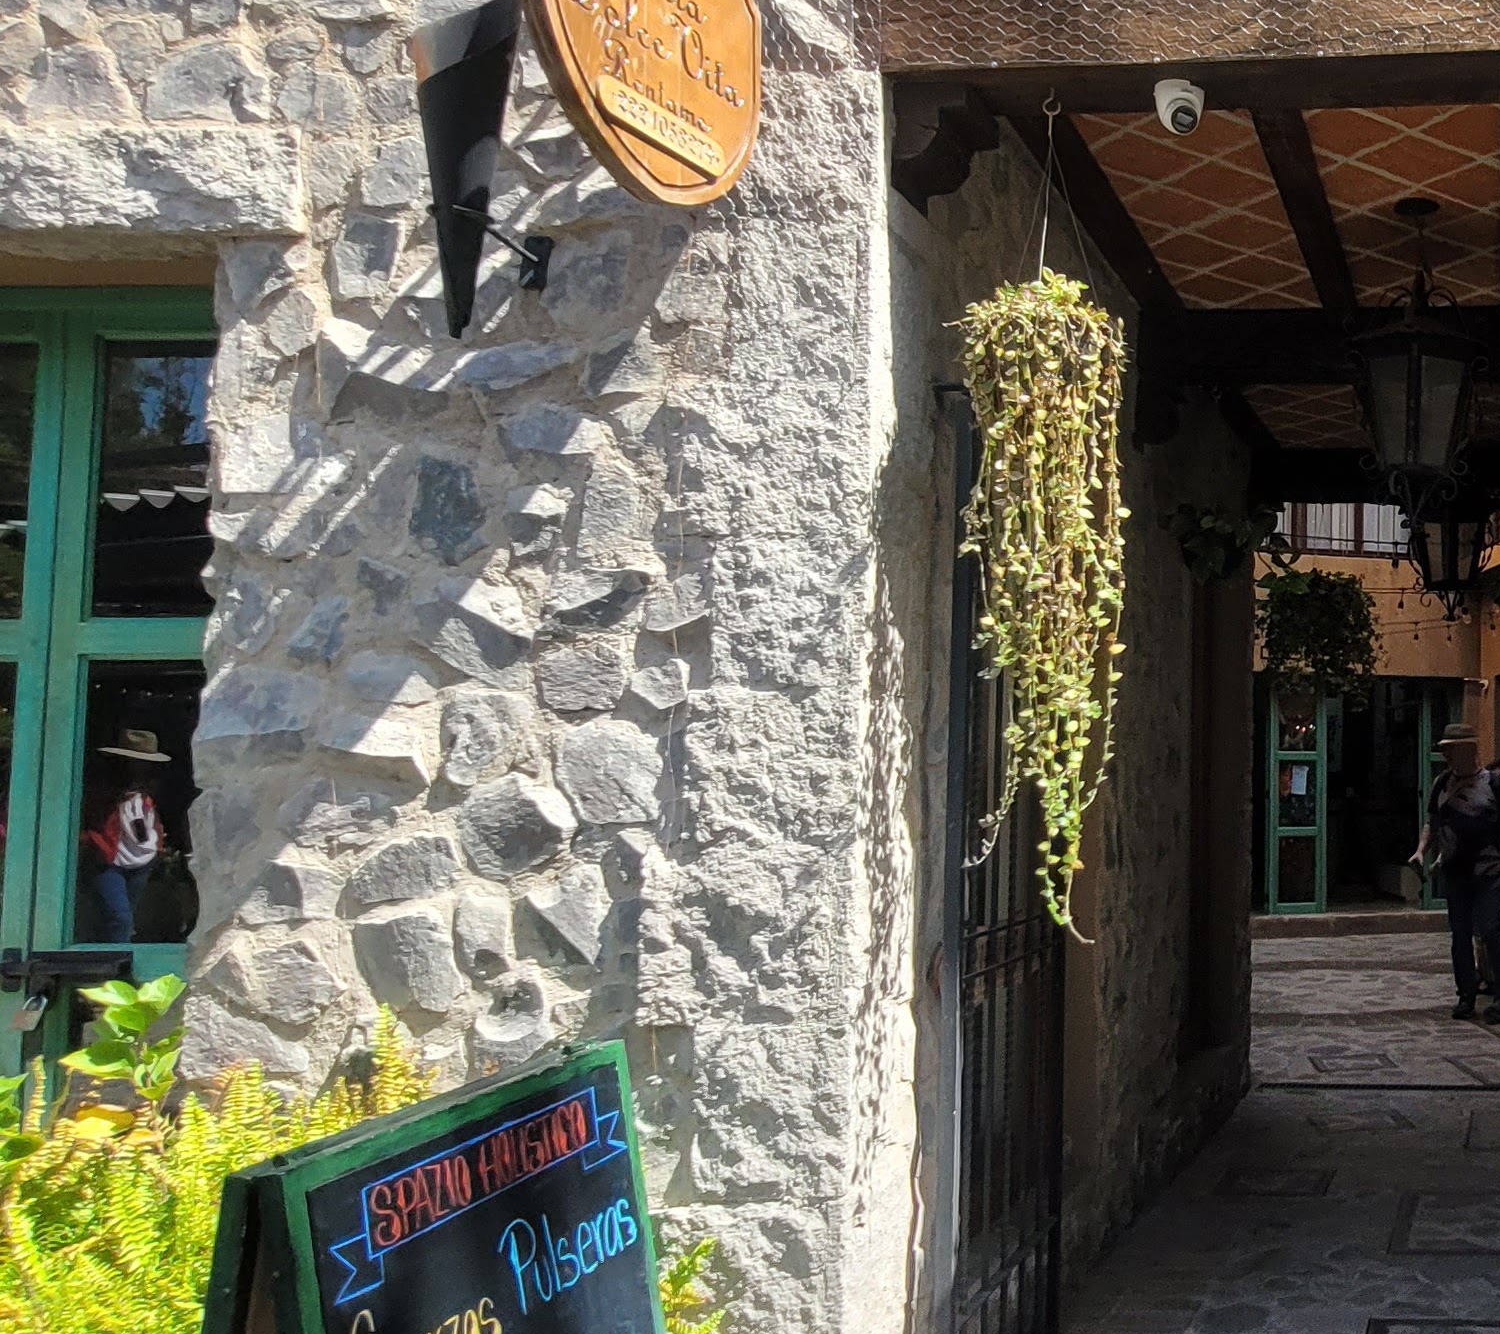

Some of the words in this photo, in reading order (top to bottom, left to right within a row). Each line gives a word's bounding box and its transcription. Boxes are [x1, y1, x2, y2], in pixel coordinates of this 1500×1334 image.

[668, 12, 745, 108] Vita
[369, 1155, 472, 1247] SPAZIO
[479, 1100, 588, 1195] HOLISTICO
[497, 1197, 638, 1315] Pulseras
